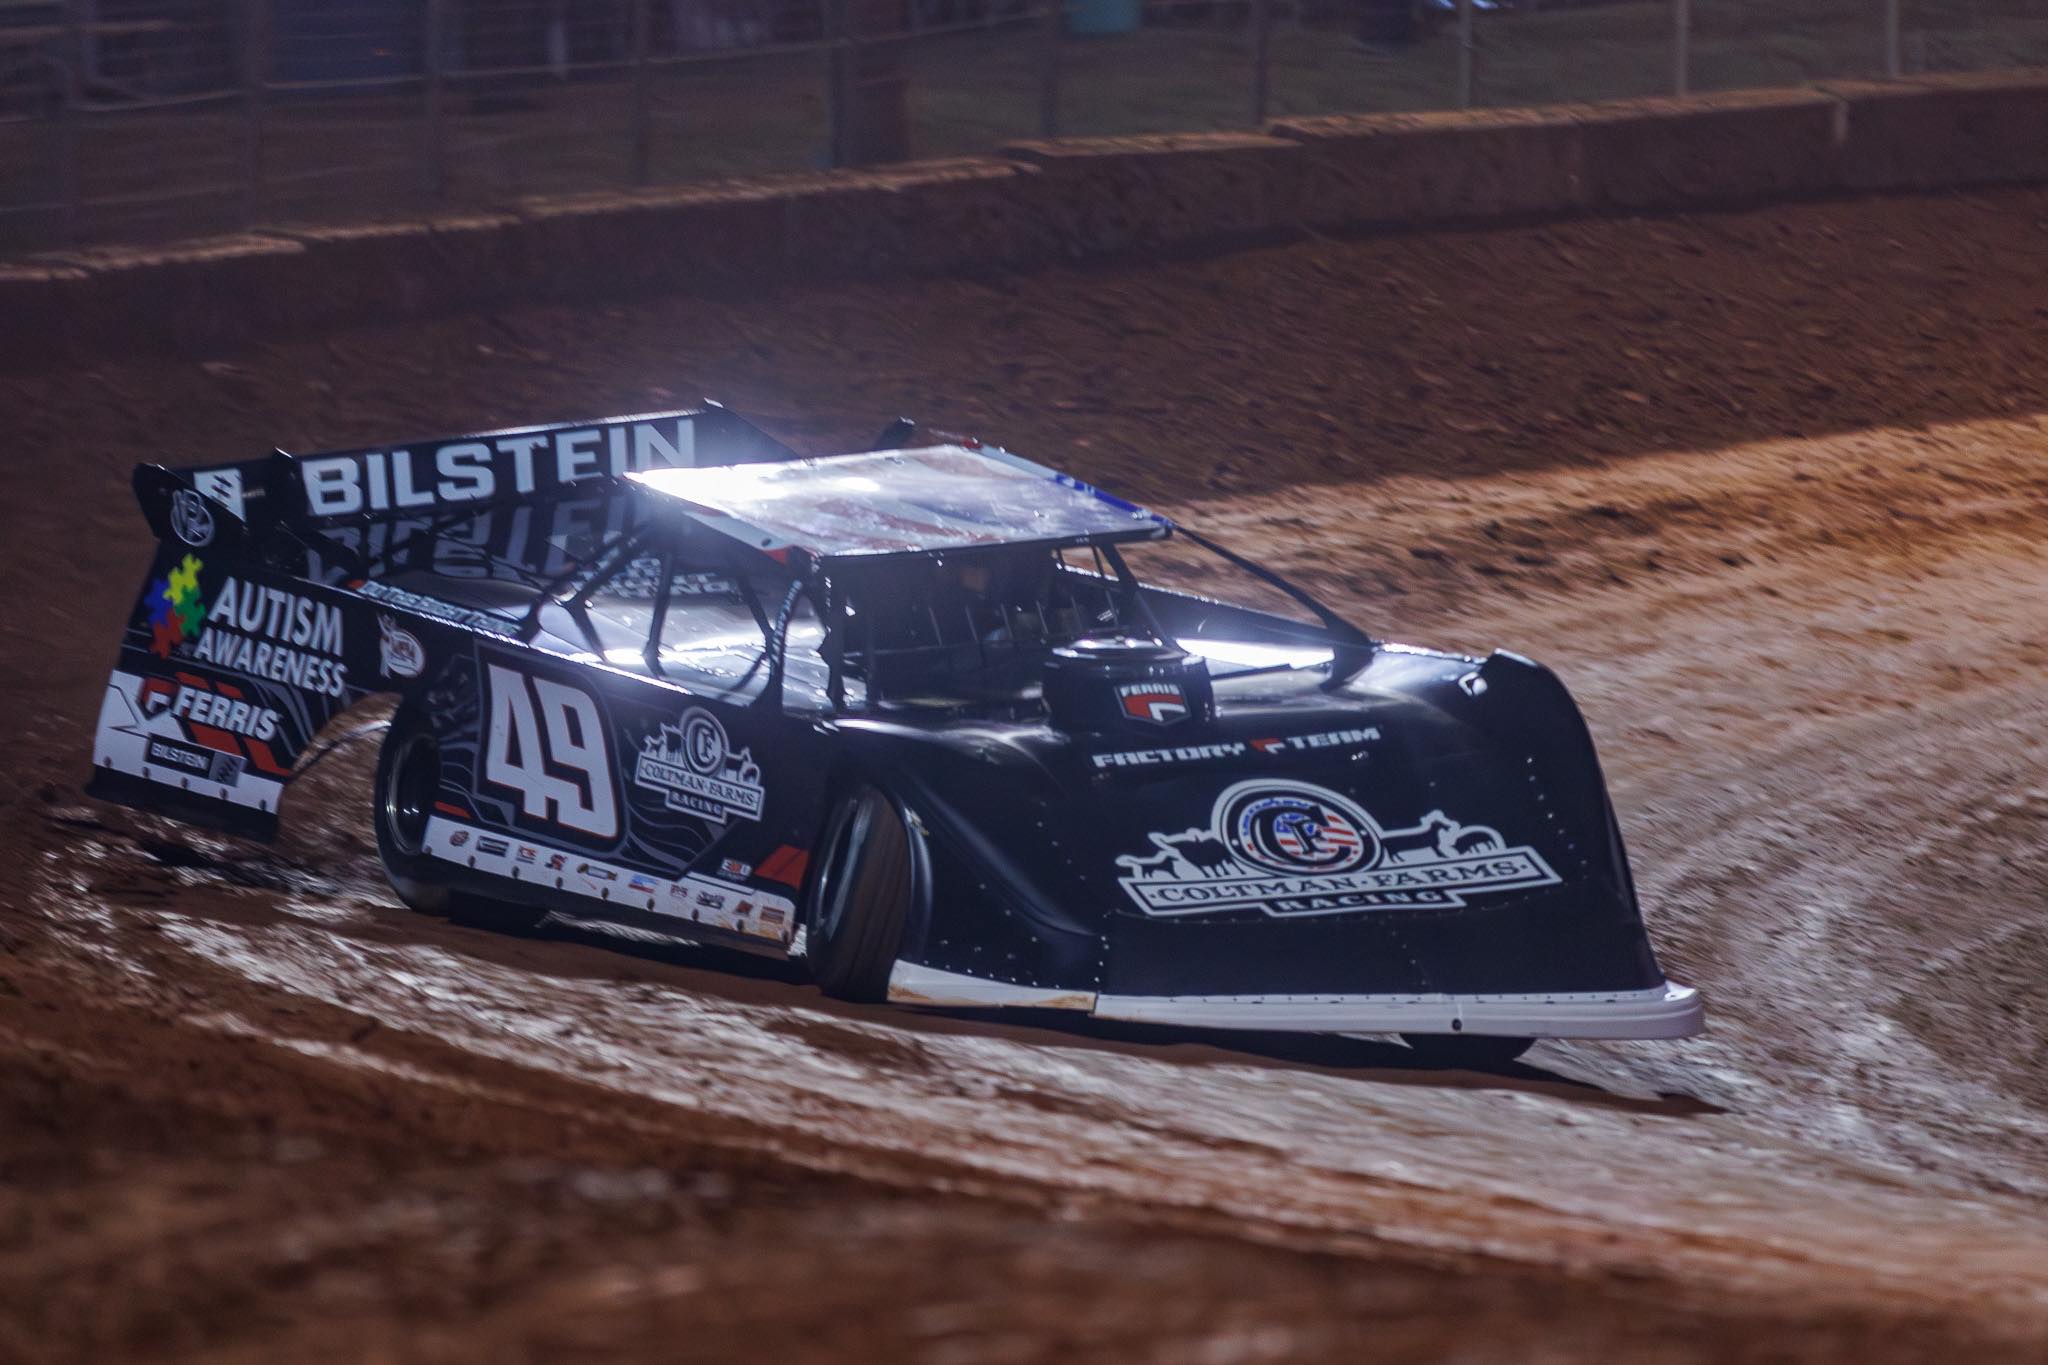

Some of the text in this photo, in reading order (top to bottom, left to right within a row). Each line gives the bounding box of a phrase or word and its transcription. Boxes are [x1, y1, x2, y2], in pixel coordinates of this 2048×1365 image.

[301, 418, 696, 516] BILSTEIN
[207, 575, 344, 657] AUTISM
[192, 626, 349, 698] AWARENESS
[1119, 683, 1181, 698] FERRIS
[172, 683, 281, 742] FERRIS
[150, 742, 210, 771] BILSTEIN
[486, 663, 618, 838] 49
[1091, 726, 1382, 768] FACTORY TEAM
[645, 763, 757, 808] COLTMAN FARMS
[670, 791, 722, 814] RACING
[1158, 860, 1520, 902] COLTMAN FARMS
[1278, 889, 1444, 912] RACING
